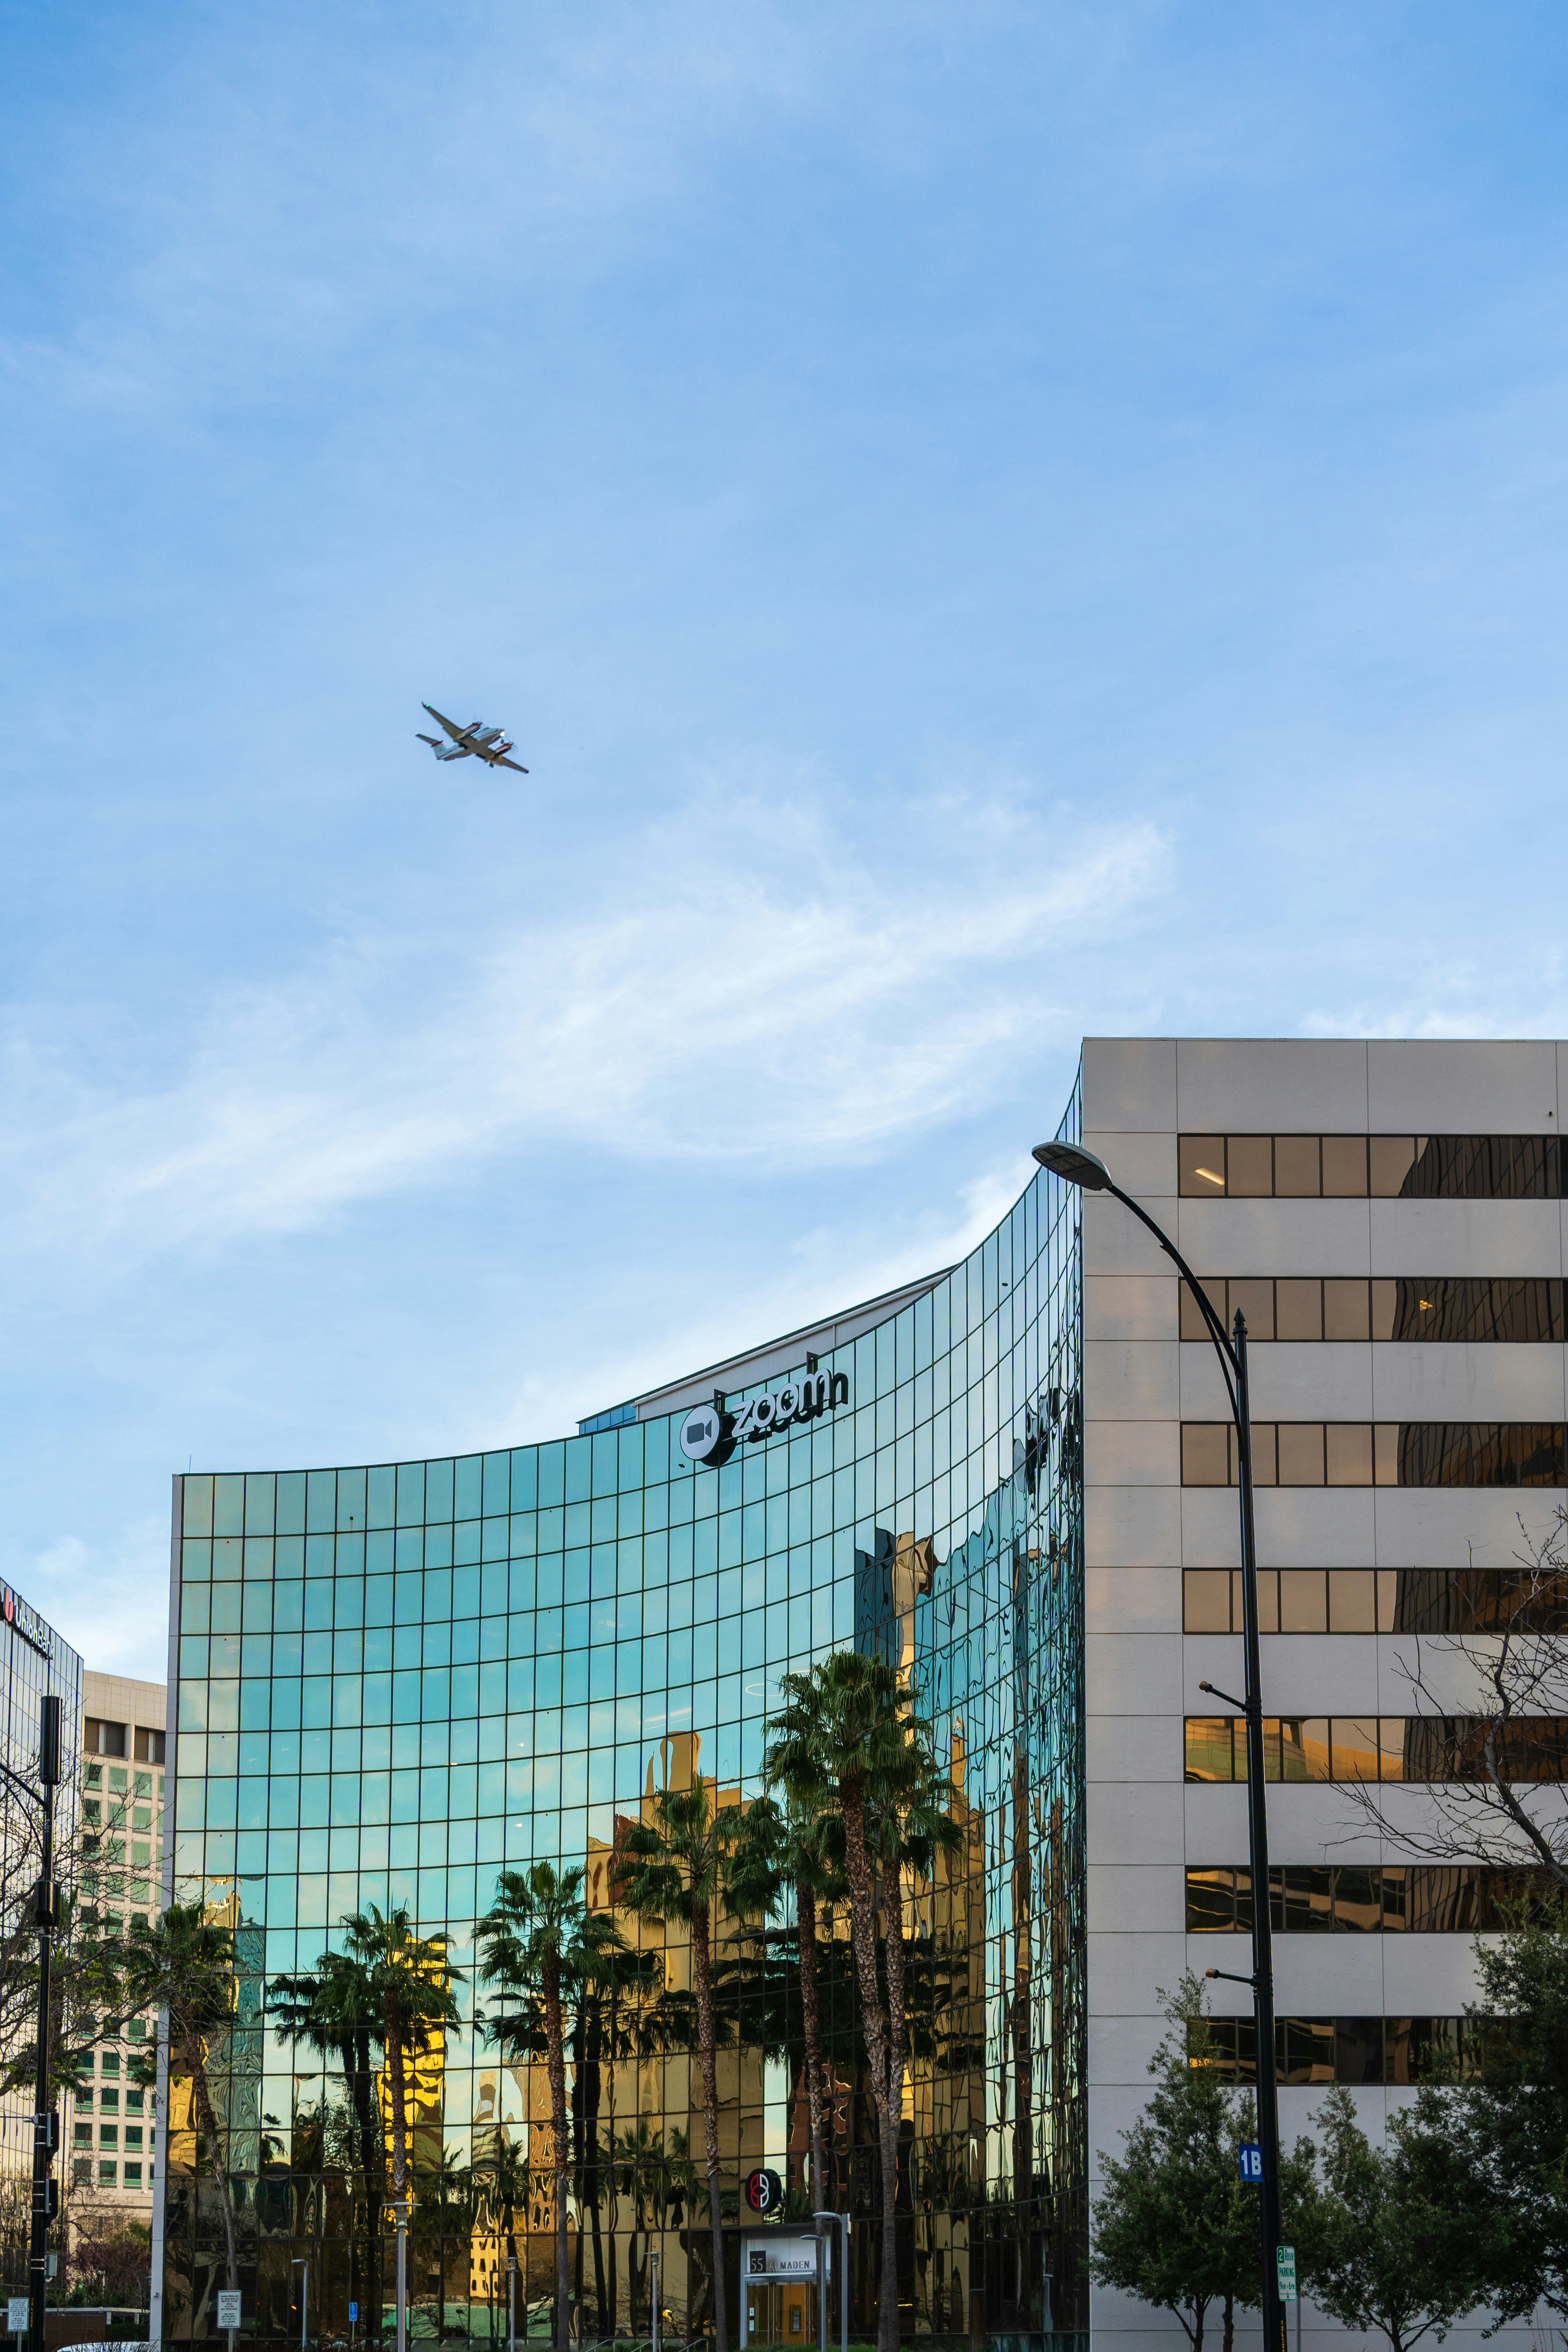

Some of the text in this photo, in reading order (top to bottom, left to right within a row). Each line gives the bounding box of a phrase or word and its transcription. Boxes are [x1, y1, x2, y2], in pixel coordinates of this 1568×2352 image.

[731, 1367, 832, 1438] zoom
[1241, 2150, 1262, 2175] 1B
[1279, 2249, 1294, 2261] 2 HOUR
[751, 2258, 810, 2272] 55 ALMADEN
[1279, 2267, 1295, 2277] PARKING
